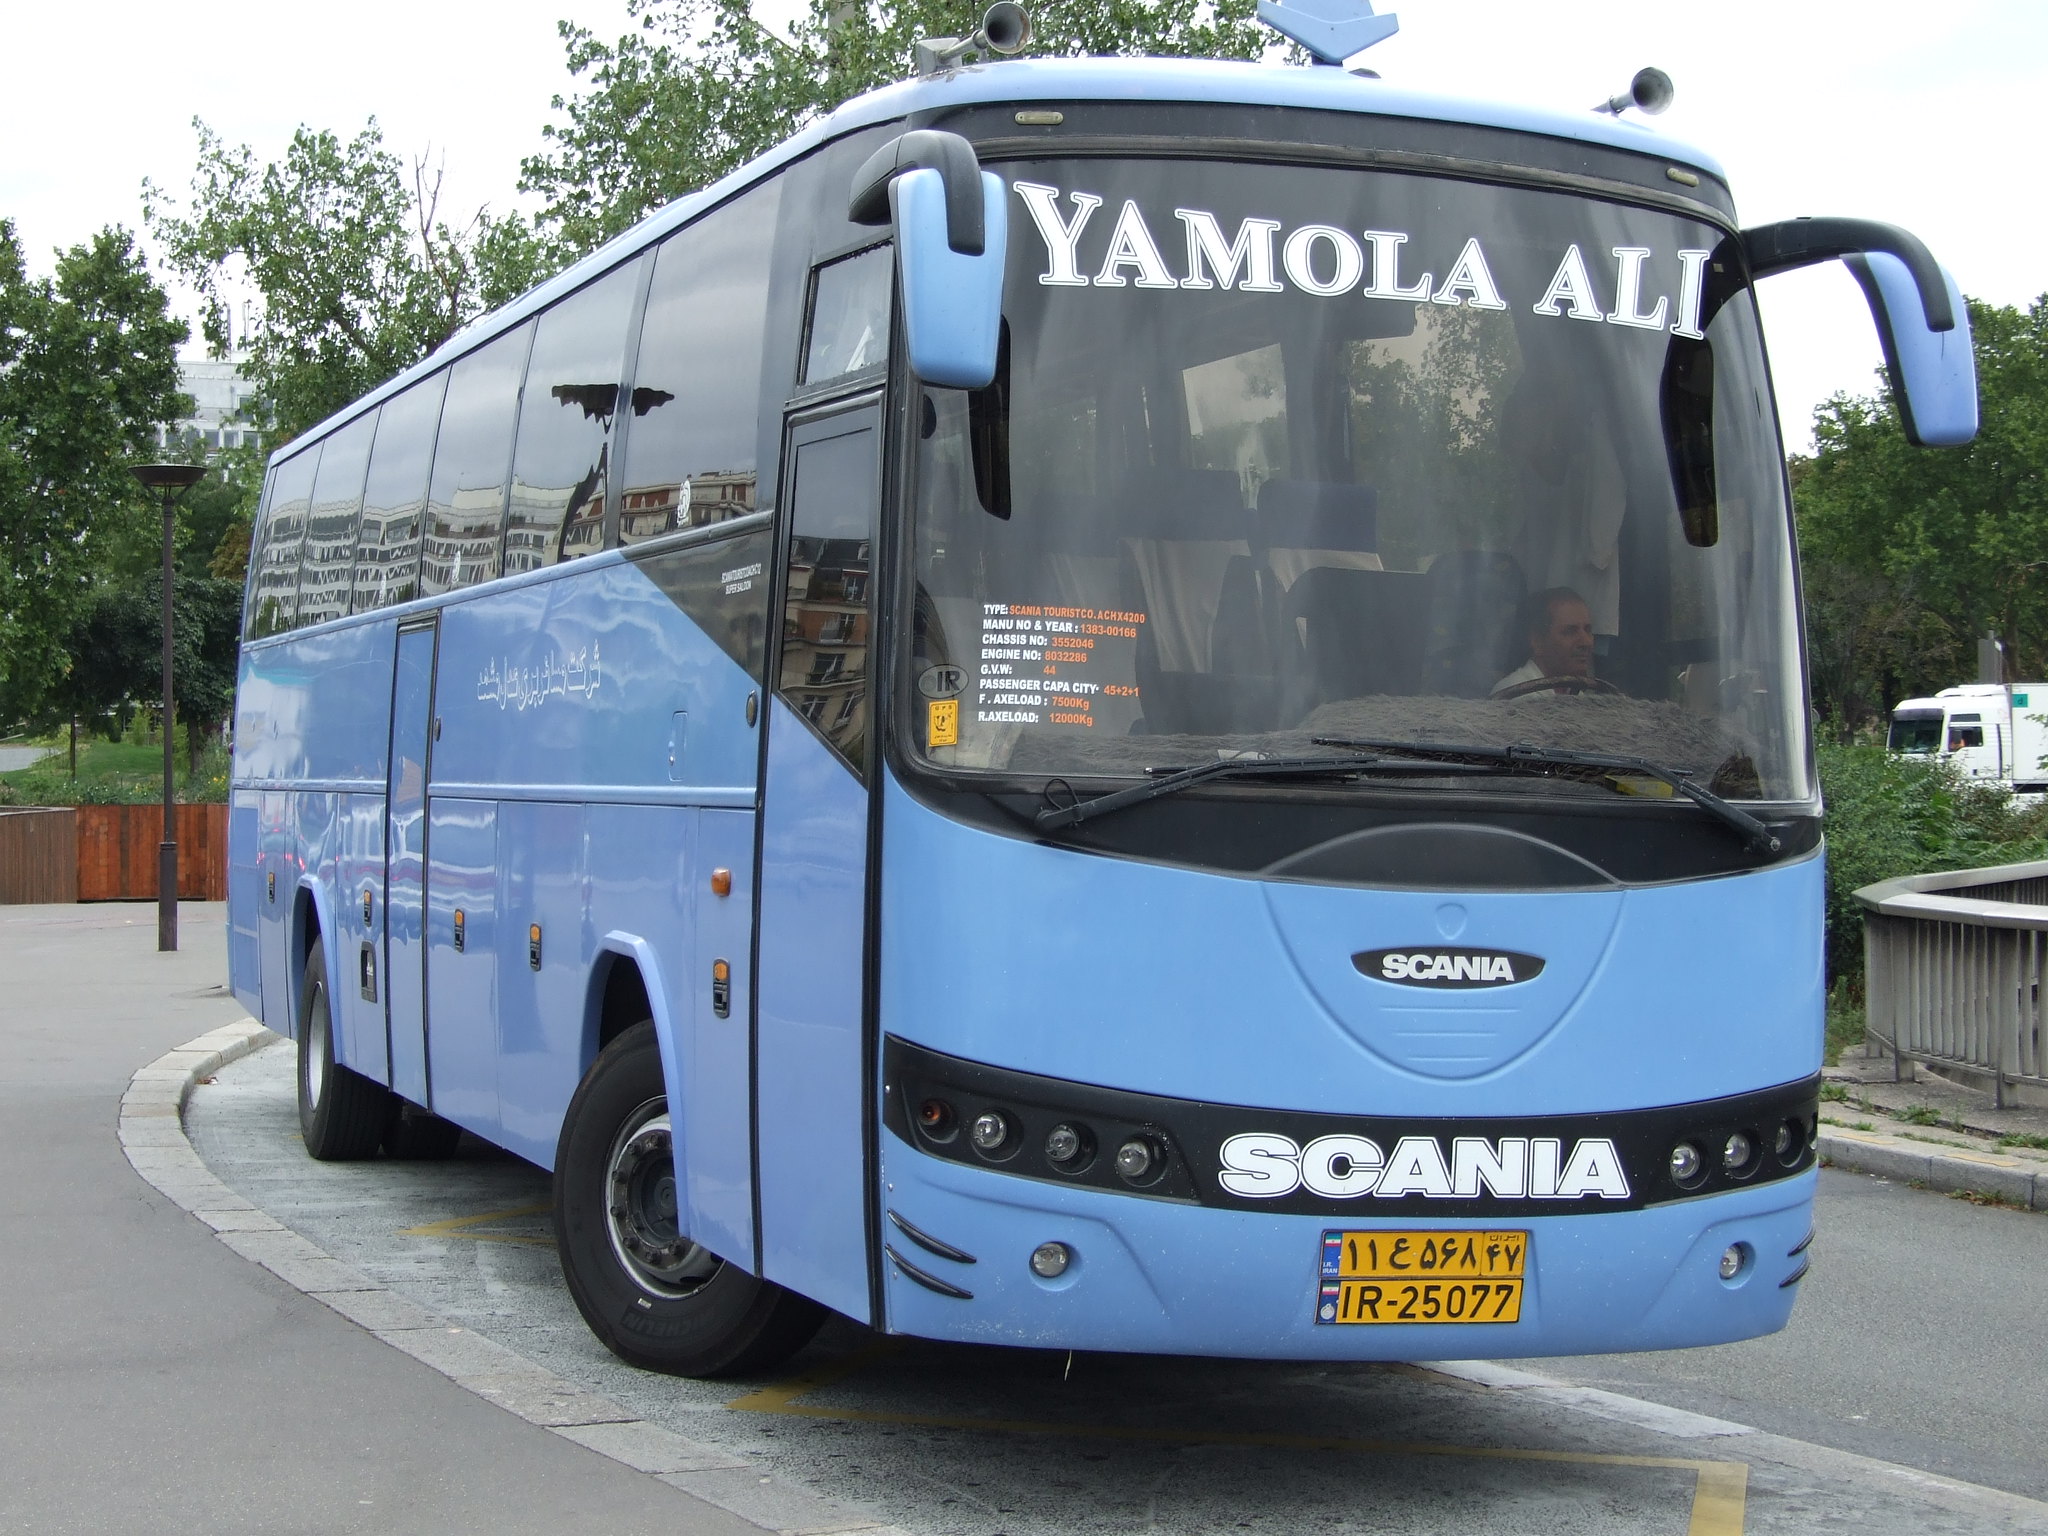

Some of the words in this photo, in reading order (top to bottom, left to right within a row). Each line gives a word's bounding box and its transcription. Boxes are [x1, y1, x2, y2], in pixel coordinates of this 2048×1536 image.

[1013, 181, 1506, 310] YAMOLA
[1533, 244, 1710, 340] ALI
[983, 604, 1009, 615] TYPE:
[1009, 605, 1042, 616] SCANIA
[982, 619, 1014, 630] MANU
[1016, 620, 1032, 630] NO
[1034, 620, 1042, 631] &
[1080, 623, 1137, 638] 1383-00166
[982, 633, 1027, 645] CHASSIS
[1029, 635, 1048, 646] NO:
[1051, 636, 1094, 649] 3552046
[981, 648, 1021, 660] ENGINE
[1022, 649, 1042, 661] NO:
[1044, 650, 1088, 662] 8032286
[980, 664, 1013, 675] G.V.W:
[1043, 665, 1057, 675] 44
[937, 671, 960, 692] IR
[979, 678, 1041, 691] PASSENGER
[1043, 680, 1071, 692] CAPA
[1103, 684, 1141, 697] 45+2+1
[1052, 695, 1090, 711] 7500Kg
[977, 711, 1039, 723] R.AXELOAD:
[1049, 712, 1094, 727] 12000Kg
[1381, 953, 1516, 983] SCANIA
[1218, 1132, 1631, 1199] SCANIA
[1341, 1284, 1515, 1320] IR-25077
